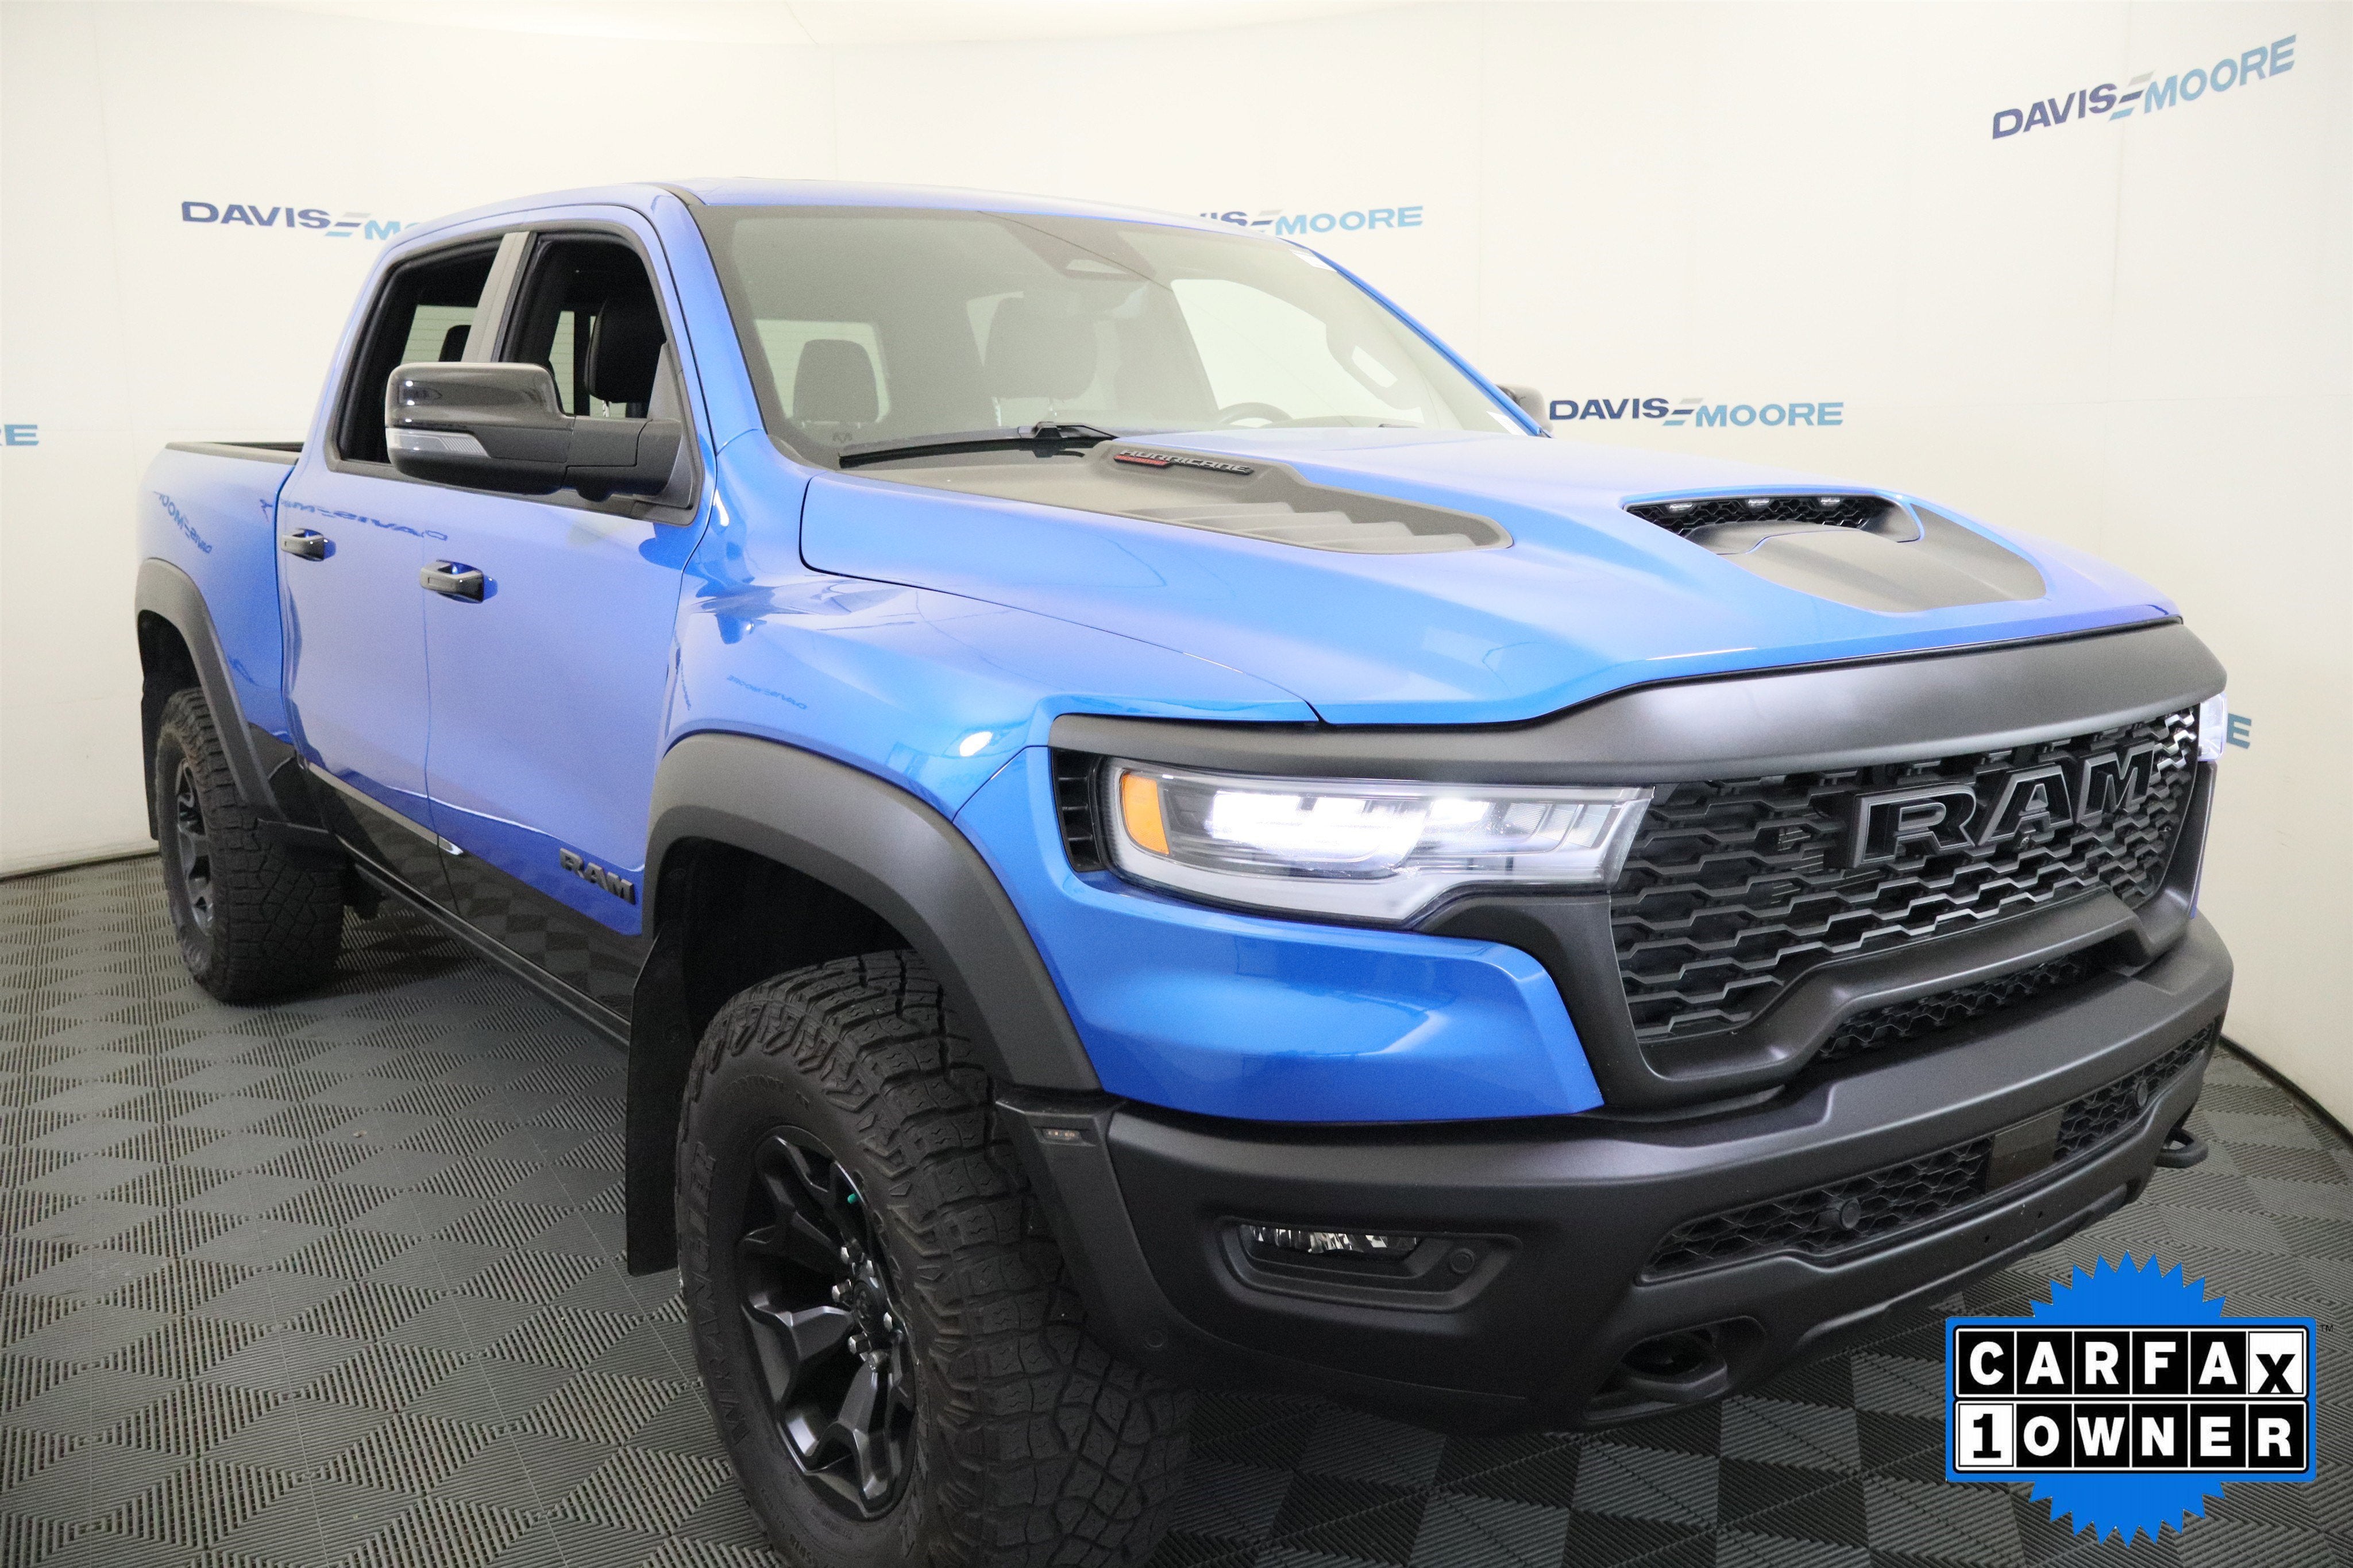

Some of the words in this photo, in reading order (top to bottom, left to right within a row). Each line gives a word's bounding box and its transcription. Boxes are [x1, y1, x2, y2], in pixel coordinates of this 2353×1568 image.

[1992, 82, 2117, 140] DAVIS
[2143, 33, 2297, 114] MOORE
[181, 201, 331, 229] DAVIS
[1275, 205, 1424, 236] MOORE
[1549, 397, 1671, 420] DAVIS
[1695, 401, 1844, 427] MOORE
[1120, 449, 1251, 473] HURRICANE
[1851, 739, 2156, 869] RAM
[560, 847, 637, 905] RAM
